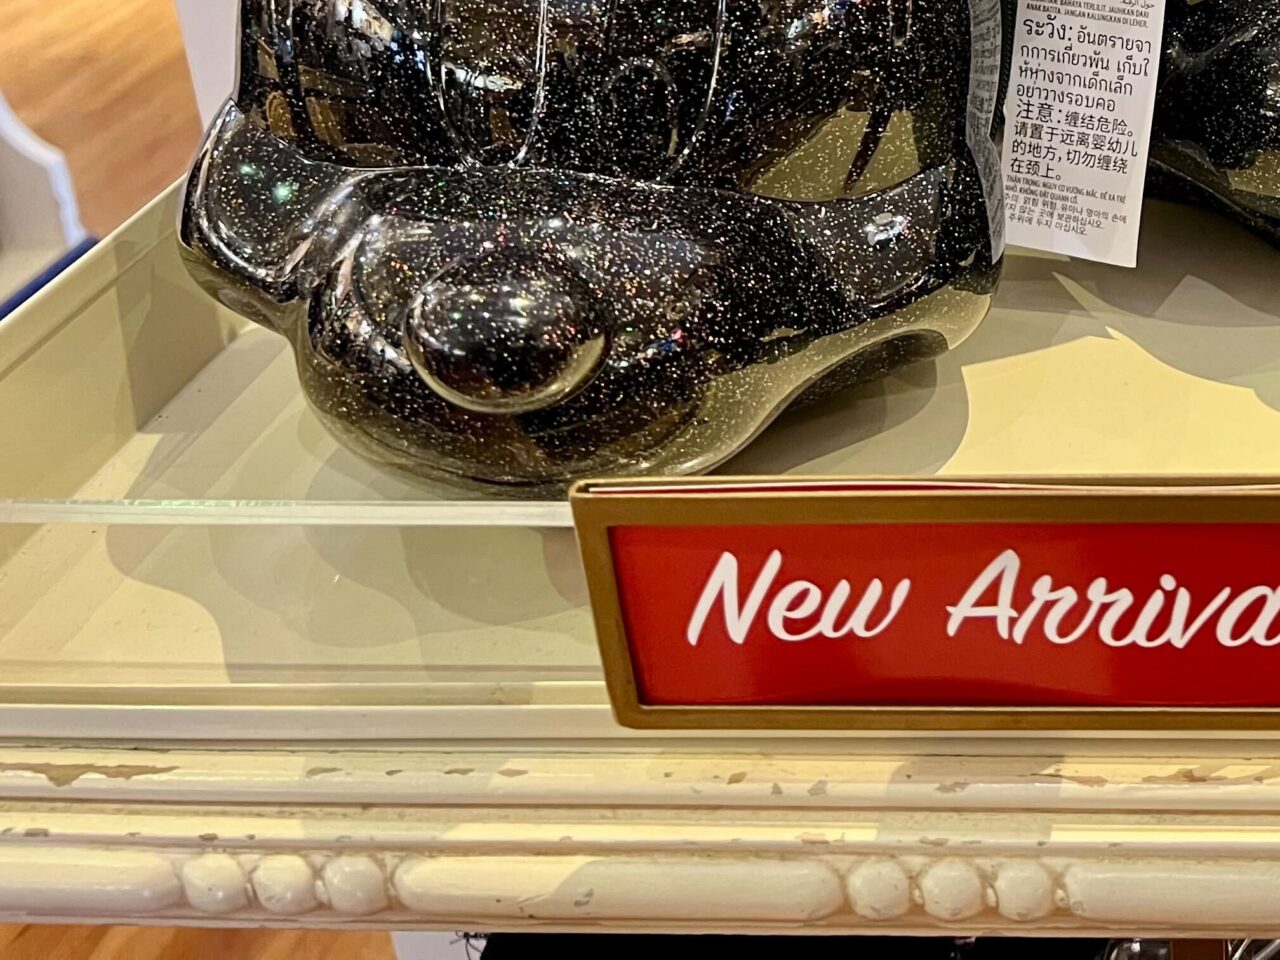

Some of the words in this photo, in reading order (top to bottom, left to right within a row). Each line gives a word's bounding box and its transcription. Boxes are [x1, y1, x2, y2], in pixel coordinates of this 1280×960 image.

[1022, 13, 1070, 41] ระวัง:
[1013, 120, 1139, 157] 请置于远离婴幼儿
[1009, 156, 1062, 181] 在颈上。
[687, 549, 911, 646] New
